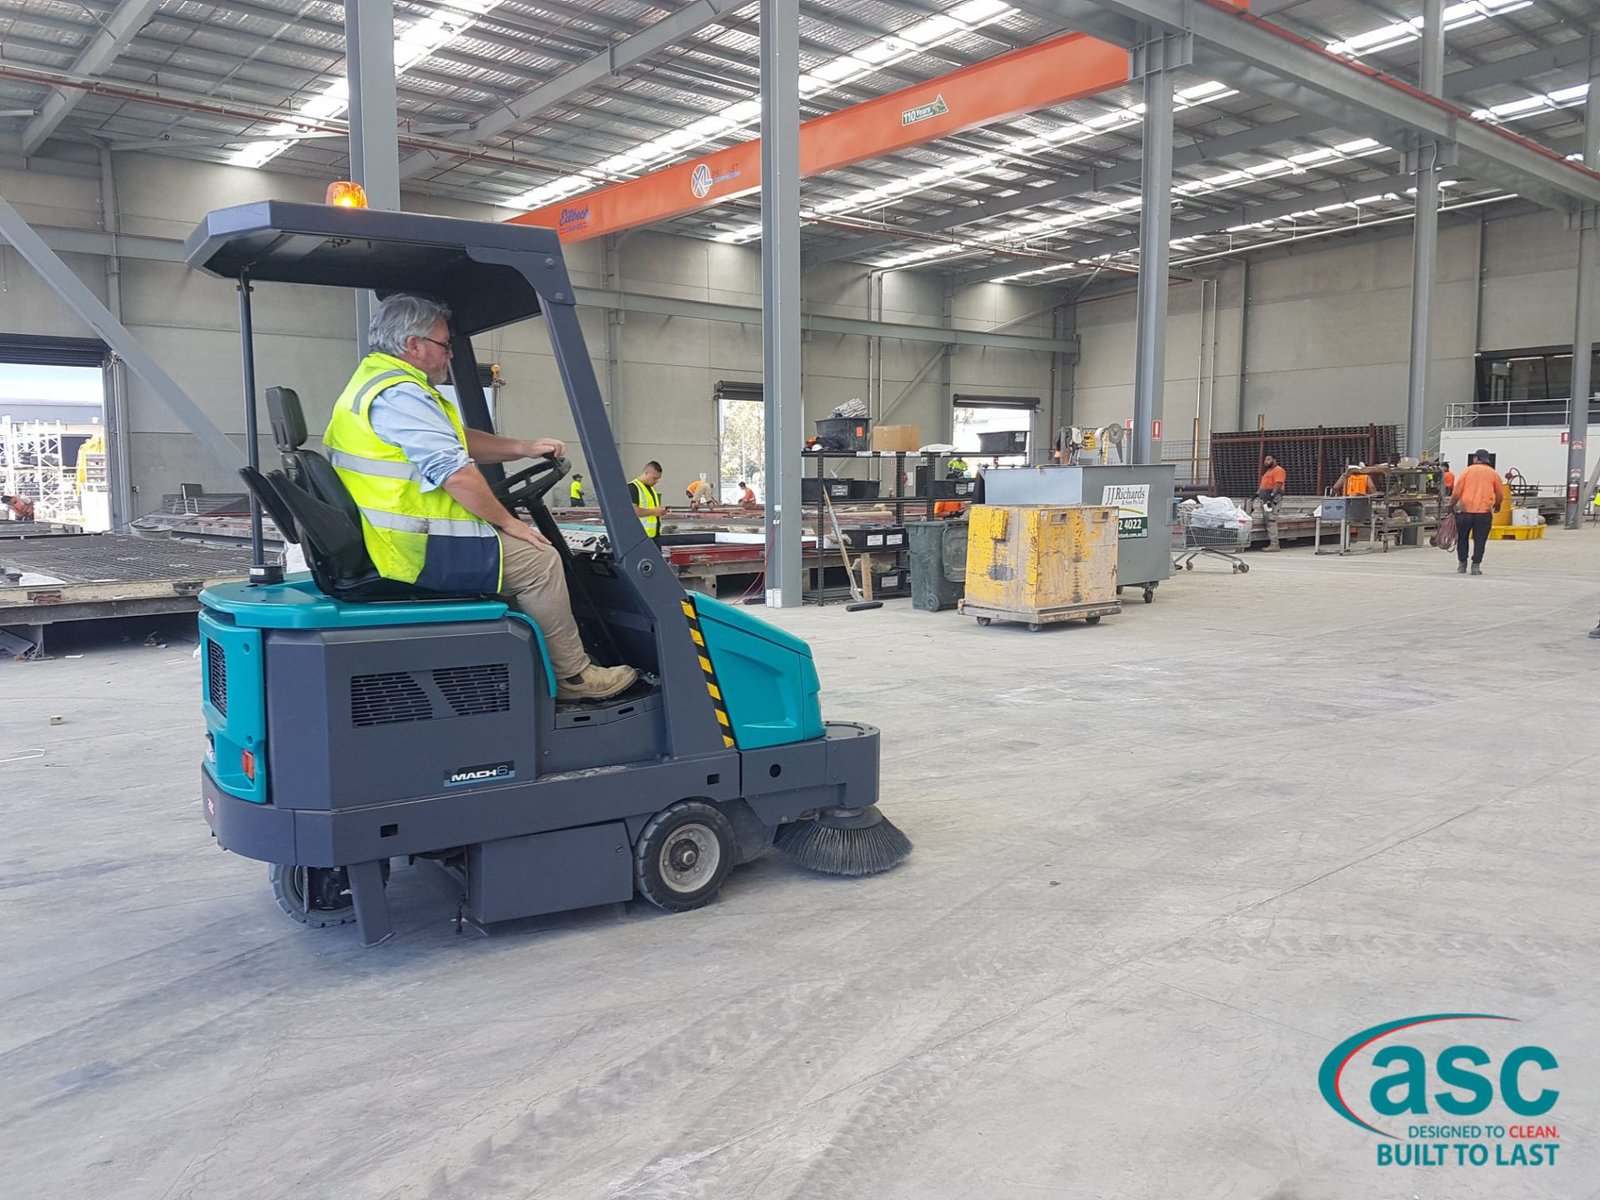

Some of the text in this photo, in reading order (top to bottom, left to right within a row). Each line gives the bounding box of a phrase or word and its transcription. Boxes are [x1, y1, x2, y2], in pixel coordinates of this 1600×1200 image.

[903, 110, 916, 123] 110
[1114, 487, 1146, 500] Richards
[1124, 518, 1142, 529] 4022
